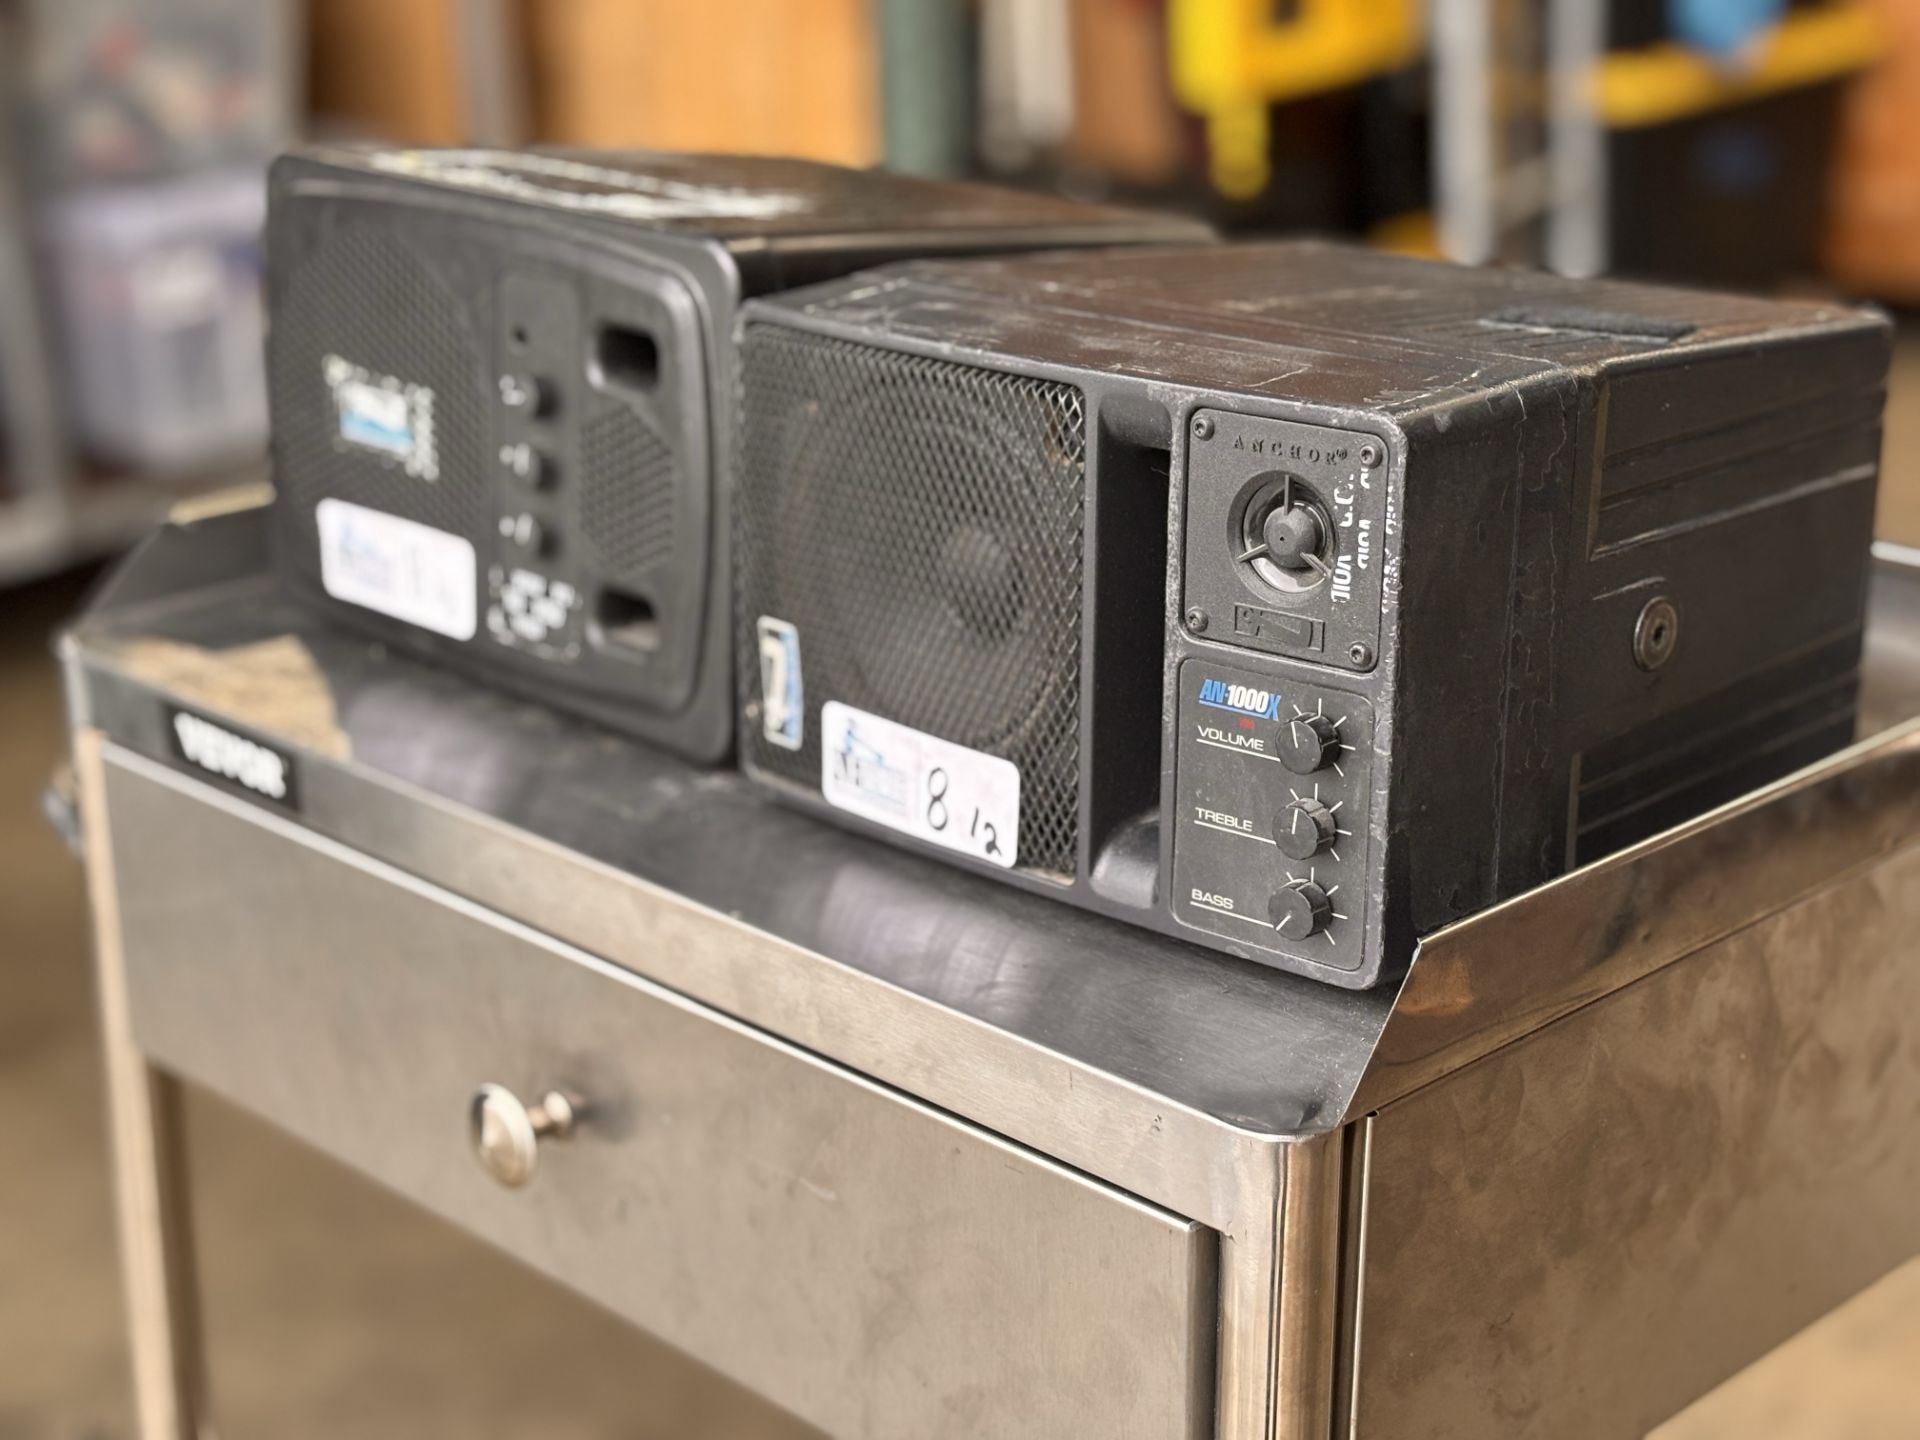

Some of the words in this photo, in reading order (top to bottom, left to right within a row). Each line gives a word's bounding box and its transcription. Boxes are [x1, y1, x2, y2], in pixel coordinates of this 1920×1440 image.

[1198, 678, 1282, 721] AN-1000X
[1197, 724, 1265, 752] VOLUME
[926, 766, 949, 832] 8
[1194, 806, 1253, 832] TREBLE
[1191, 888, 1235, 911] BASS
